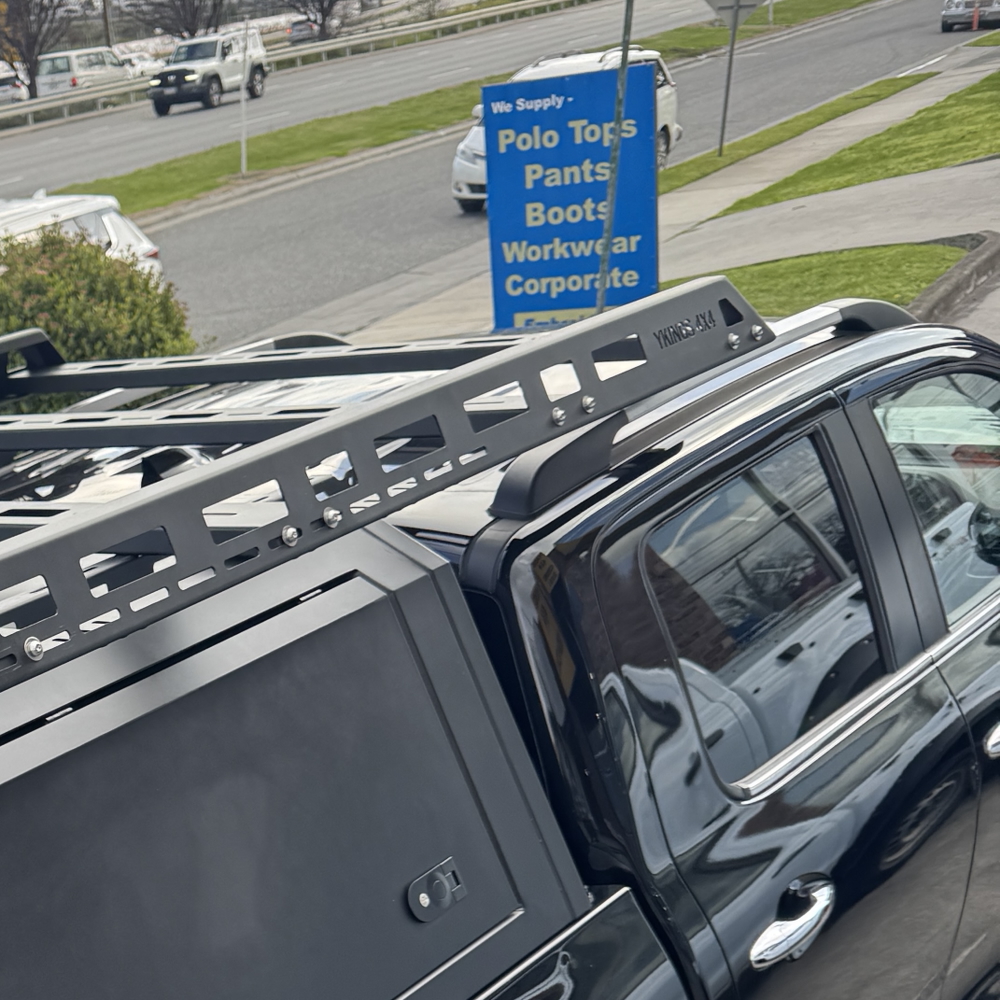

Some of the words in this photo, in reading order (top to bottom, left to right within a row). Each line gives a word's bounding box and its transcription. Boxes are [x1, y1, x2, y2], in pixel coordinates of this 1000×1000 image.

[491, 100, 513, 114] We
[515, 94, 565, 112] Supply
[498, 125, 560, 154] Polo
[567, 119, 638, 147] Tops
[524, 158, 611, 189] Pants
[525, 198, 609, 227] Boots
